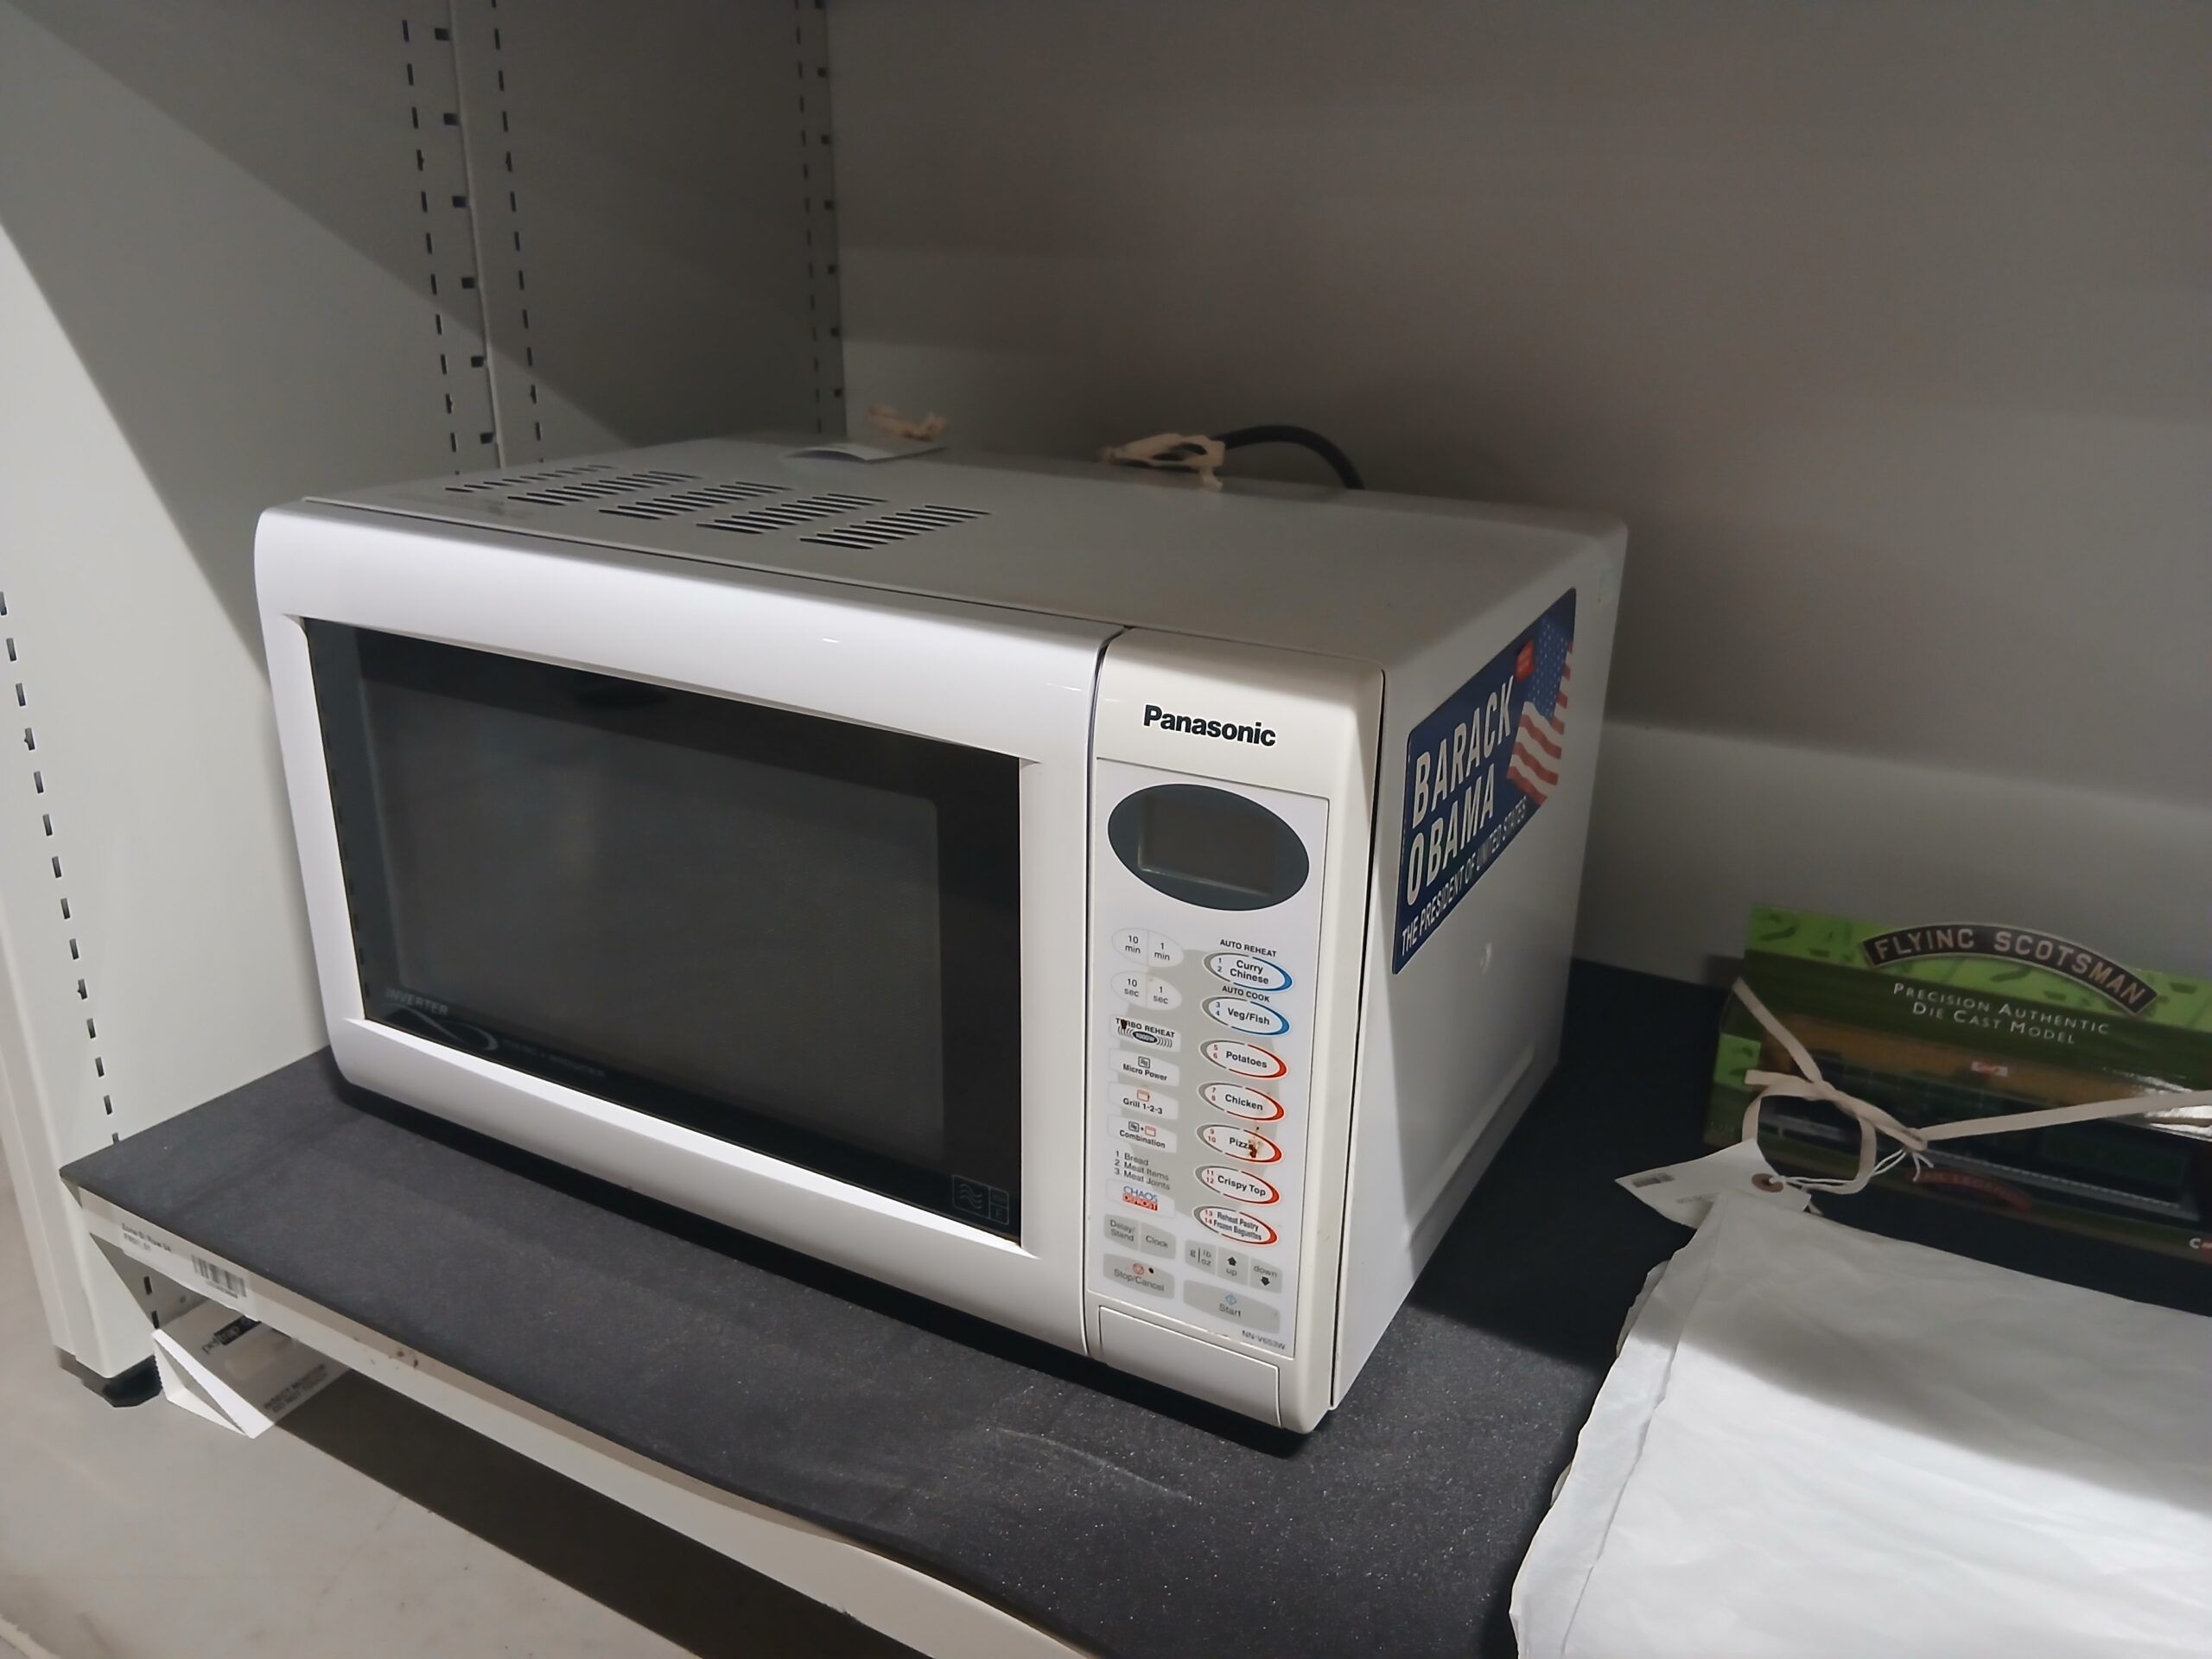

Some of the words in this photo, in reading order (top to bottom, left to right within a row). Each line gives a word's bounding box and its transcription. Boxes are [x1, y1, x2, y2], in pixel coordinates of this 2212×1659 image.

[1144, 704, 1276, 747] Panasonic
[1412, 676, 1514, 830] BARACK
[1407, 763, 1496, 906] OBAMA
[1402, 914, 1420, 957] THE
[1419, 865, 1465, 937] PRESIDENT
[1465, 851, 1477, 885] OF
[1128, 935, 1139, 944] 10
[1160, 942, 1165, 950] 1
[1219, 938, 1243, 950] AUTO
[1243, 944, 1277, 958] REHEAT
[1124, 944, 1141, 954] min
[1154, 951, 1171, 961] min
[1230, 968, 1269, 985] Chinese
[1236, 959, 1264, 976] Curry
[1993, 931, 2146, 1006] SCOTSMAN
[1128, 978, 1138, 988] 10
[1124, 988, 1140, 998] sec
[1153, 995, 1169, 1005] sec
[1222, 985, 1244, 996] AUTO
[1245, 990, 1270, 1003] COOK
[1227, 1007, 1271, 1026] Veg/Fish
[1893, 982, 1990, 1013] PRECISION
[1999, 1002, 2111, 1036] AUTHENTIC
[1116, 1017, 1142, 1030] TRBO
[1144, 1025, 1176, 1039] REHEAT
[1953, 1009, 2001, 1030] CAST
[2010, 1020, 2076, 1046] MODEL
[1225, 1051, 1268, 1069] Potatoes
[1122, 1063, 1143, 1075] Micro
[1144, 1070, 1168, 1082] Power
[1122, 1097, 1141, 1109] Grill
[1141, 1103, 1164, 1116] 1-2-3
[1224, 1094, 1264, 1111] Chicken
[1119, 1129, 1166, 1149] Combination
[1229, 1137, 1255, 1152] Pizz
[1124, 1153, 1149, 1166] Bread
[1123, 1161, 1144, 1174] Meat
[1147, 1168, 1170, 1181] Items
[1123, 1170, 1145, 1183] Meat
[1146, 1178, 1171, 1191] Joints
[1217, 1175, 1248, 1192] Crispy
[1249, 1184, 1267, 1198] Top
[1122, 1185, 1159, 1203] CHAOS
[1146, 1235, 1169, 1249] Clock
[1225, 1268, 1237, 1277] up
[1253, 1265, 1278, 1278] down
[1218, 1302, 1242, 1317] Start
